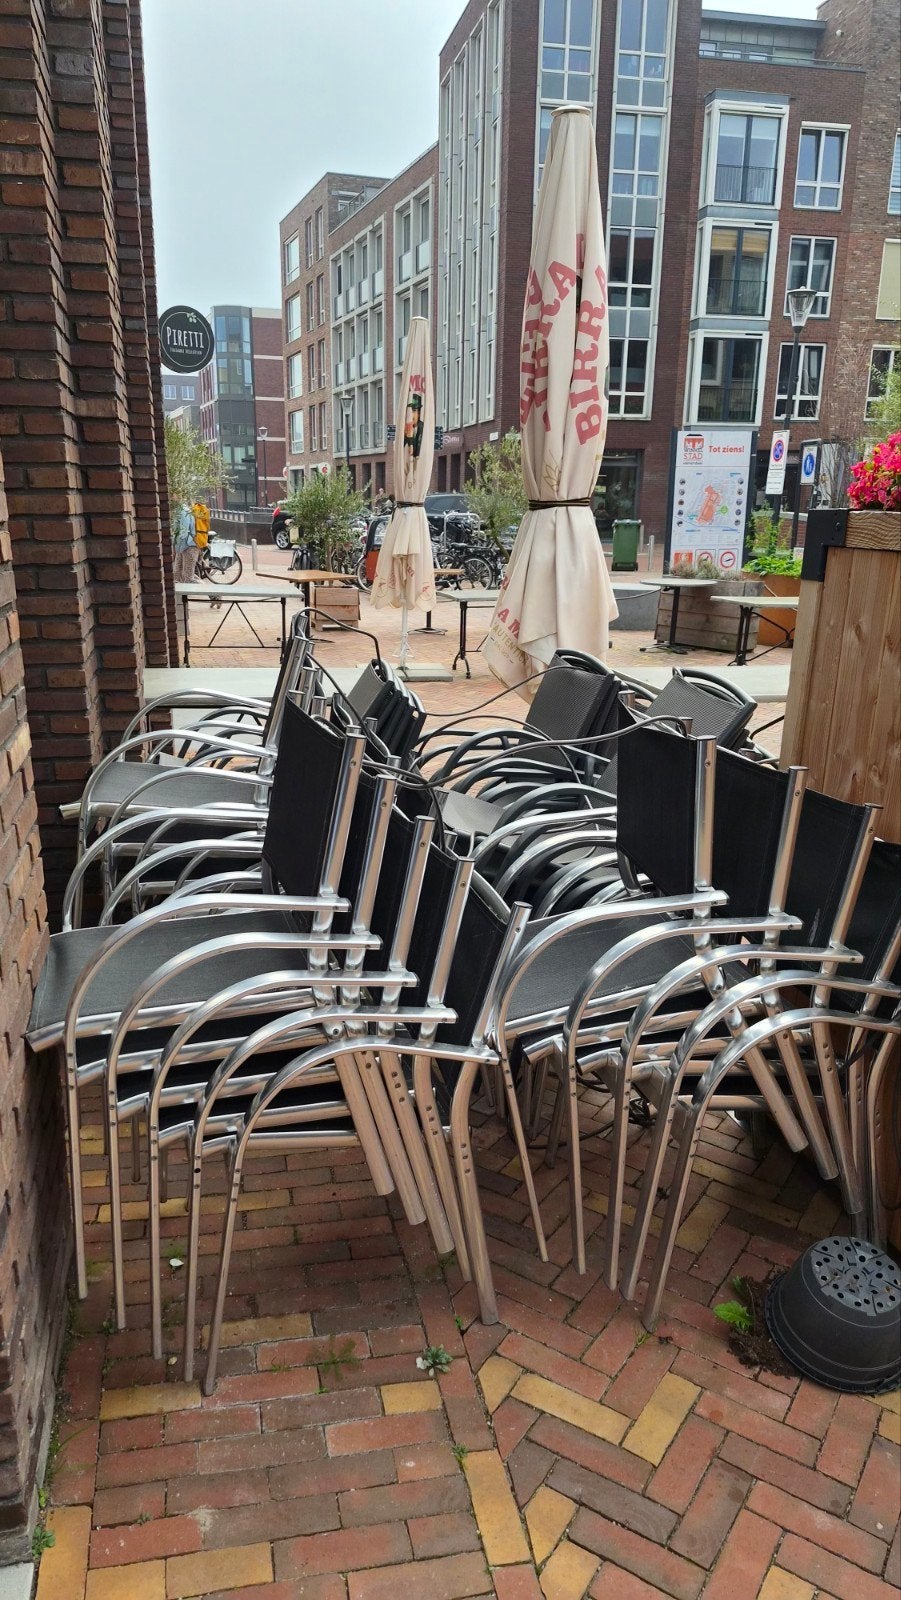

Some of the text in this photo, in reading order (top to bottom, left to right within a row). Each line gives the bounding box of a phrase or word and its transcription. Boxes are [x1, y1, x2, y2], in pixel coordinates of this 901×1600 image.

[166, 326, 205, 349] PIRETTI
[708, 445, 745, 453] Tot ziens!
[683, 452, 703, 460] STAD
